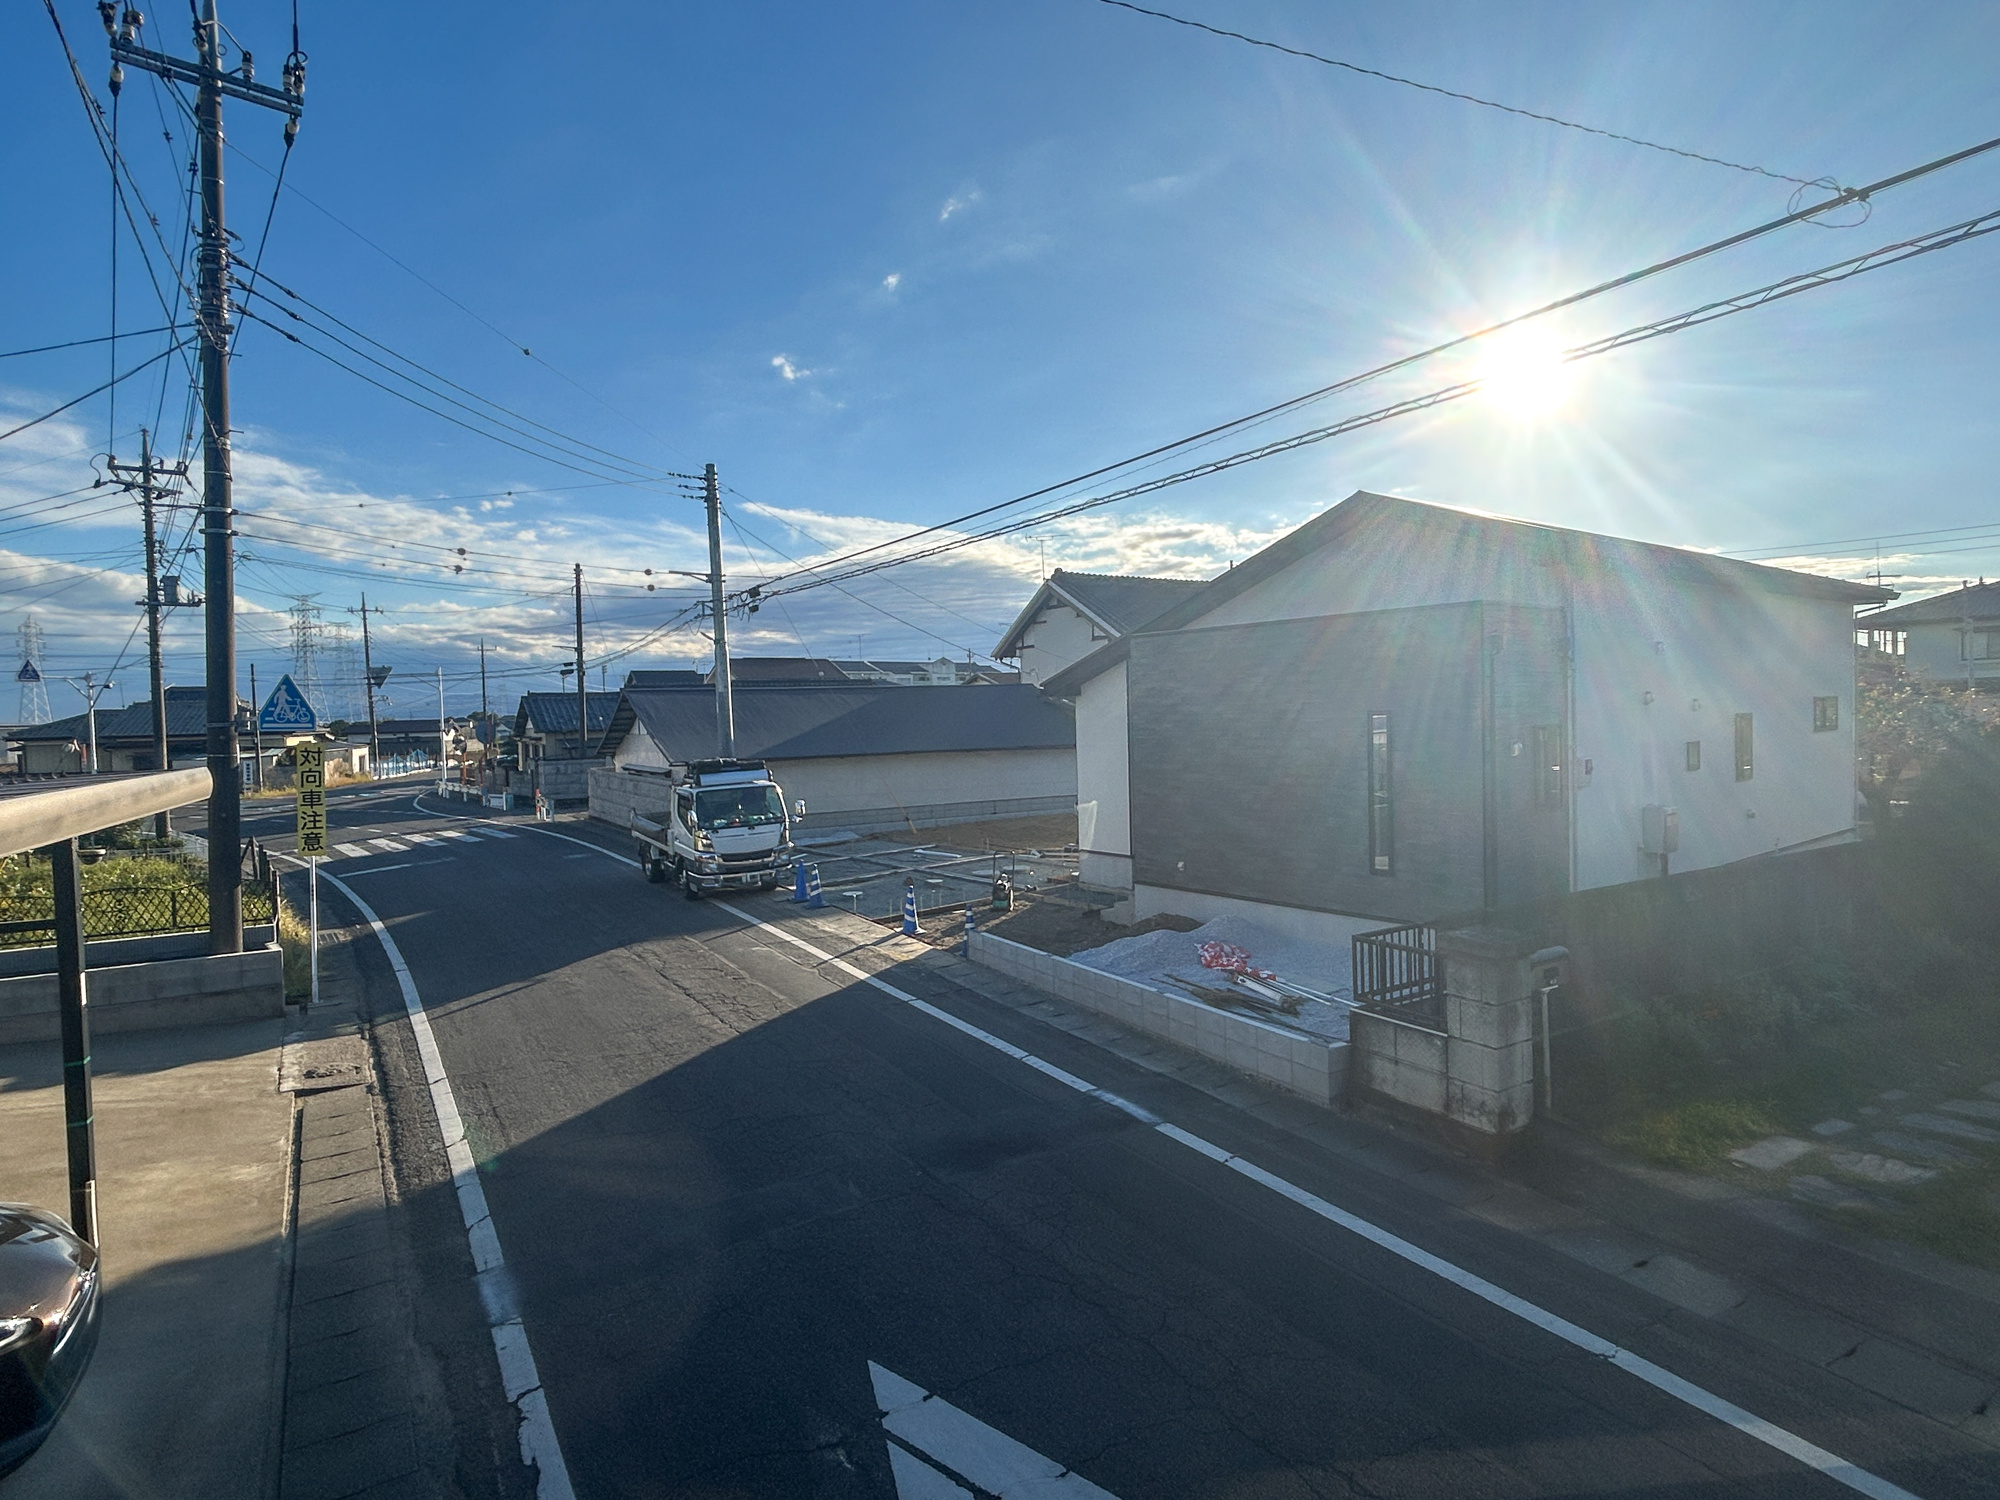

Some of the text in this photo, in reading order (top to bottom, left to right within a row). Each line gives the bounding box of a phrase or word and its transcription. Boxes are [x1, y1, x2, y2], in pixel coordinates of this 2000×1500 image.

[300, 747, 324, 852] 対向車注意
